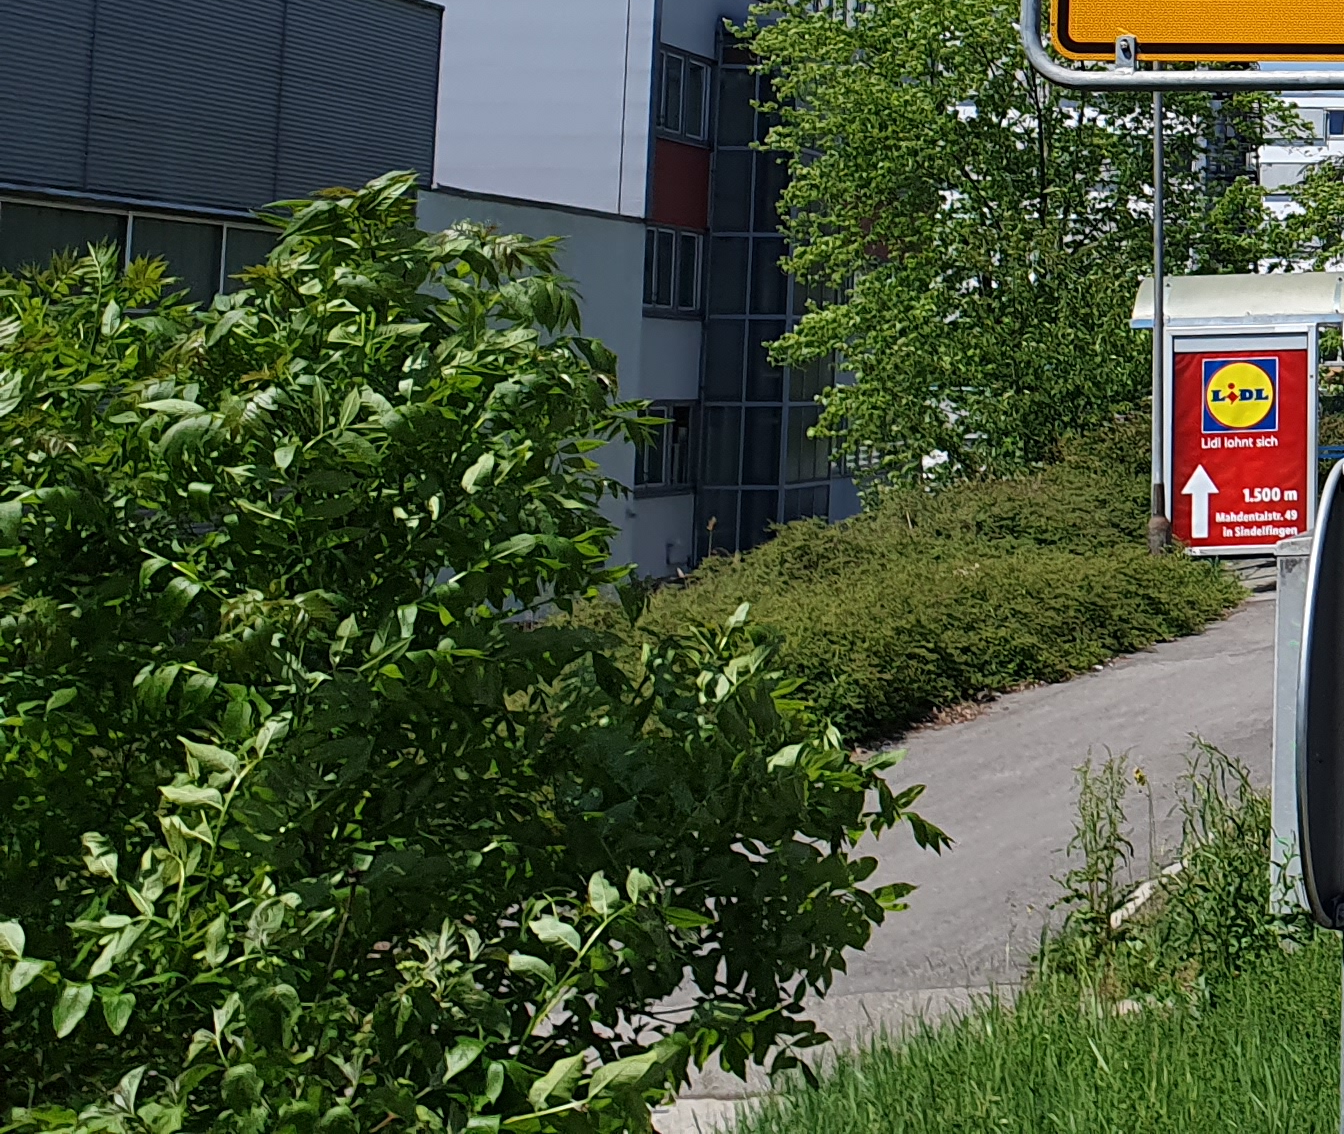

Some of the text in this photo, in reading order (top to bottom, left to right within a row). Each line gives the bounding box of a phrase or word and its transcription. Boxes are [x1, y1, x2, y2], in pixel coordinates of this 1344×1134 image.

[1201, 434, 1279, 450] Lidl lohnt sich
[1242, 487, 1298, 503] 1.500 m
[1222, 524, 1298, 538] in Sindelfingen
